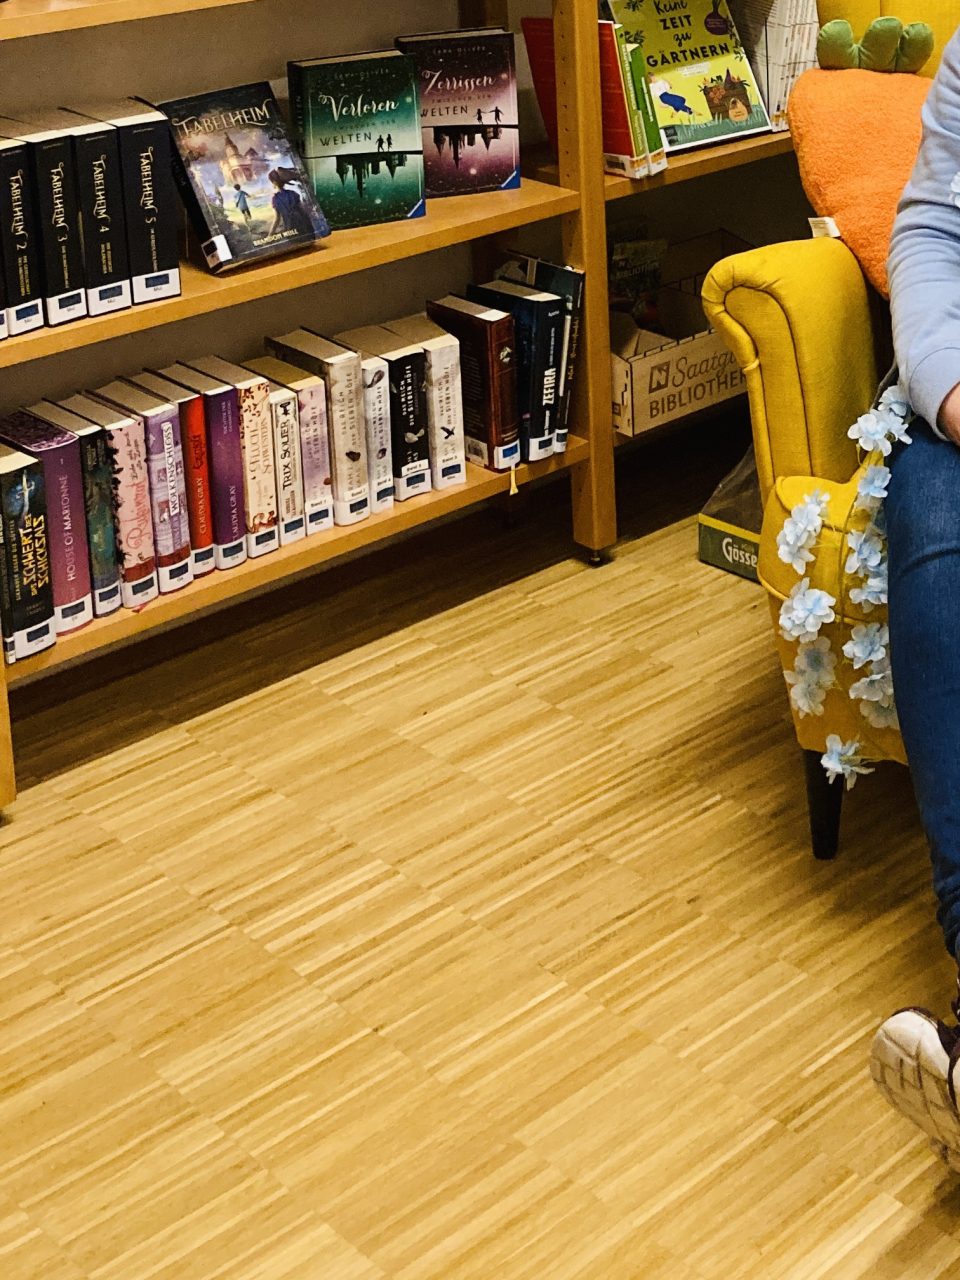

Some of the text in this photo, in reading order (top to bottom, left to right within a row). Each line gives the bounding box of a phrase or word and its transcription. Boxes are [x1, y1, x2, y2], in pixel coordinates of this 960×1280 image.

[659, 15, 692, 30] ZEIT
[673, 32, 692, 47] zu
[646, 43, 730, 68] GÄRTNERN
[421, 69, 497, 95] Zerrissen
[172, 98, 273, 136] FABELHEIM
[318, 93, 399, 122] Verloren
[420, 105, 468, 118] WELTEN
[320, 132, 372, 147] WELTEN
[92, 153, 111, 233] FABELHEIM 4
[139, 145, 158, 215] FABELHEIM
[7, 167, 29, 251] FABELHEIM 2
[49, 160, 69, 243] FABELHEIM 3
[404, 364, 414, 413] SIEBEN HÖFE
[542, 367, 556, 406] ZEFIRA
[162, 422, 180, 516] WOLKENSCHLOSS
[195, 476, 205, 498] GRAY
[281, 462, 293, 491] TRIX
[224, 484, 237, 510] GRAY
[60, 473, 76, 582] HOUSE OF MARIONNE
[199, 497, 208, 536] CLAUDIA
[20, 526, 37, 586] SCHWERT
[34, 514, 50, 589] SCHICKSALS
[722, 537, 758, 567] Gösse
